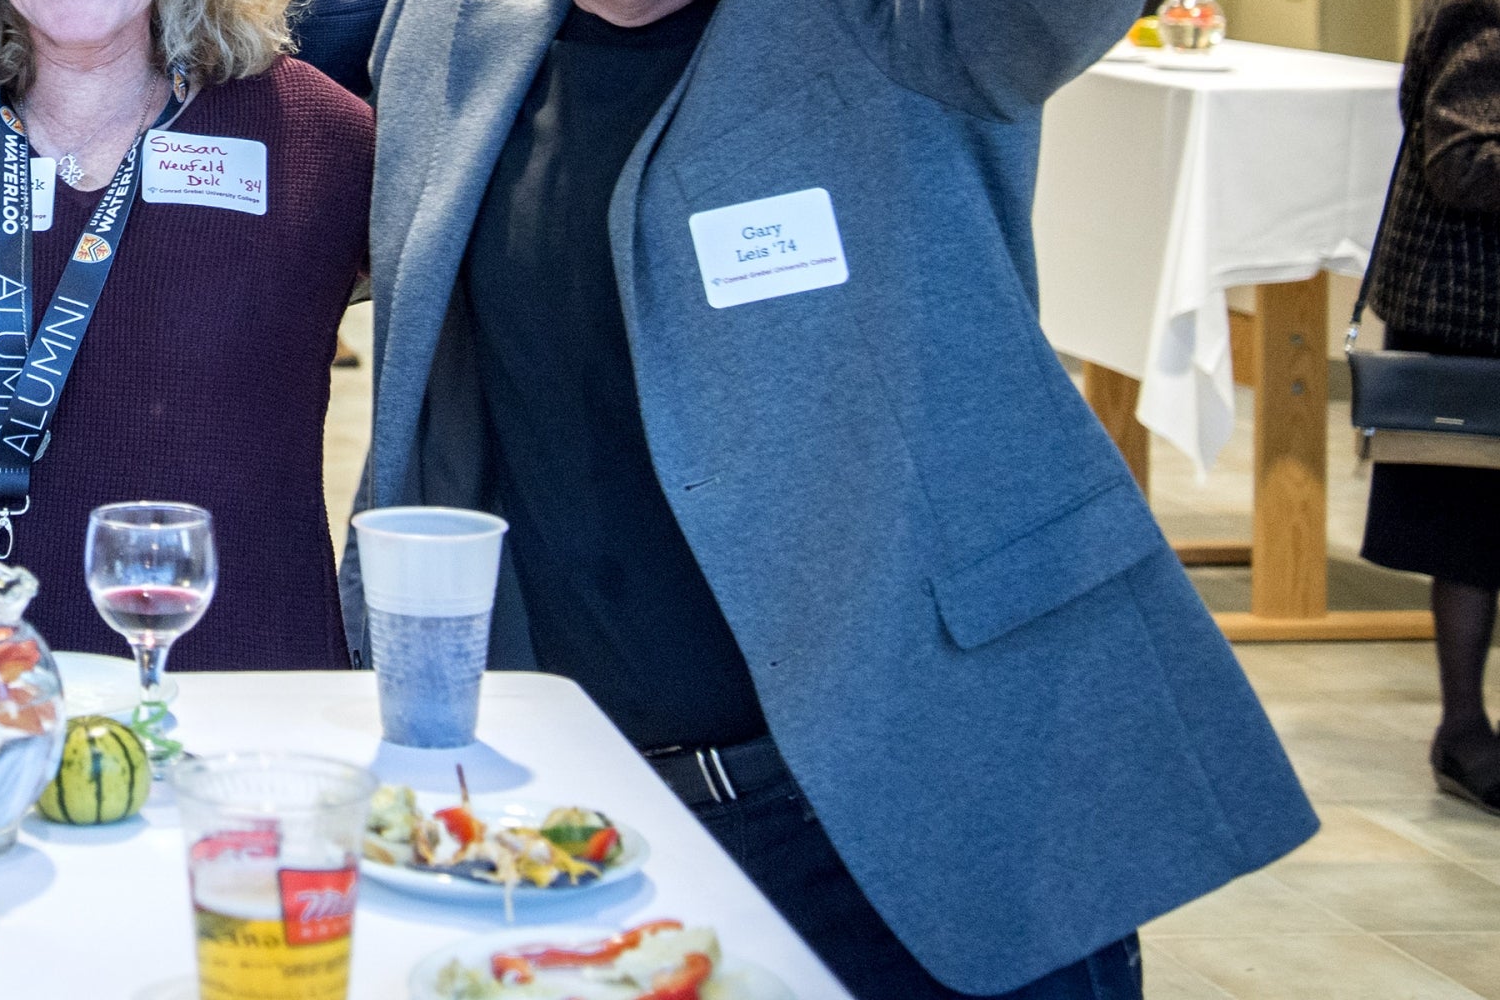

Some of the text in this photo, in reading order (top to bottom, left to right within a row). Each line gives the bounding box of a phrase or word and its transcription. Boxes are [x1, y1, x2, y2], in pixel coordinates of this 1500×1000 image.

[150, 136, 228, 155] Susan
[2, 134, 19, 235] WATERLOO
[186, 174, 262, 193] Dick '84
[742, 223, 782, 240] Gary
[736, 244, 769, 262] Leis
[2, 295, 90, 457] ALUMNI
